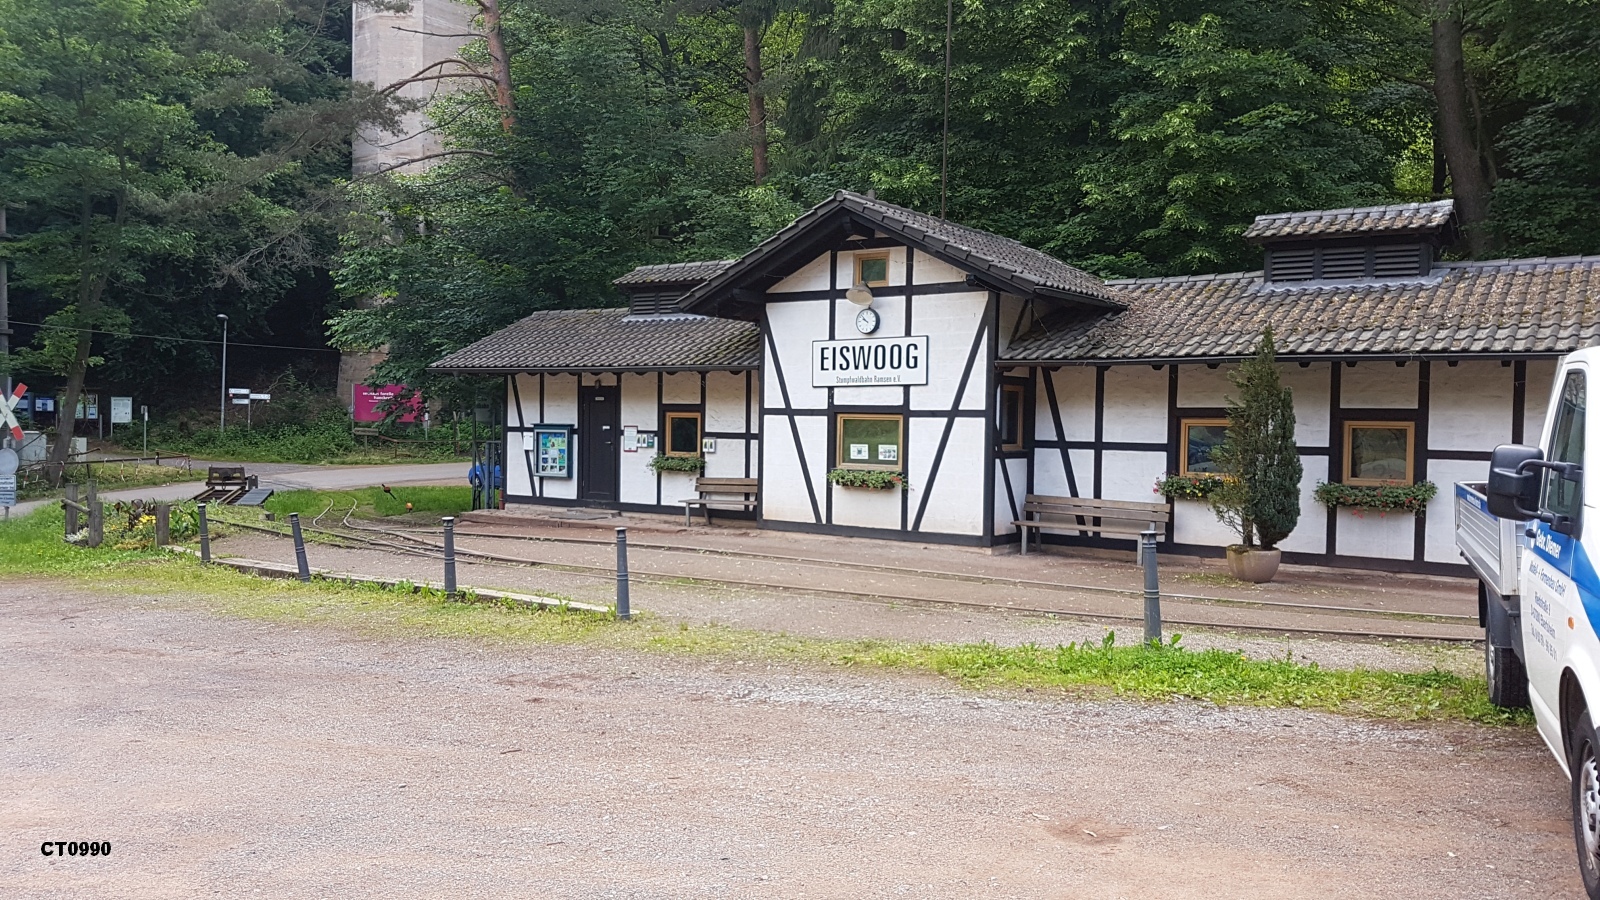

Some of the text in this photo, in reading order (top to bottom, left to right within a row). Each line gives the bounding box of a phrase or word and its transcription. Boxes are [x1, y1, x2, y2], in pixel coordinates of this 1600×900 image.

[820, 343, 918, 371] EISWOOG
[836, 375, 901, 385] Stumpfwaldbahn Ramsen e.V.
[1555, 579, 1566, 597] GmbH
